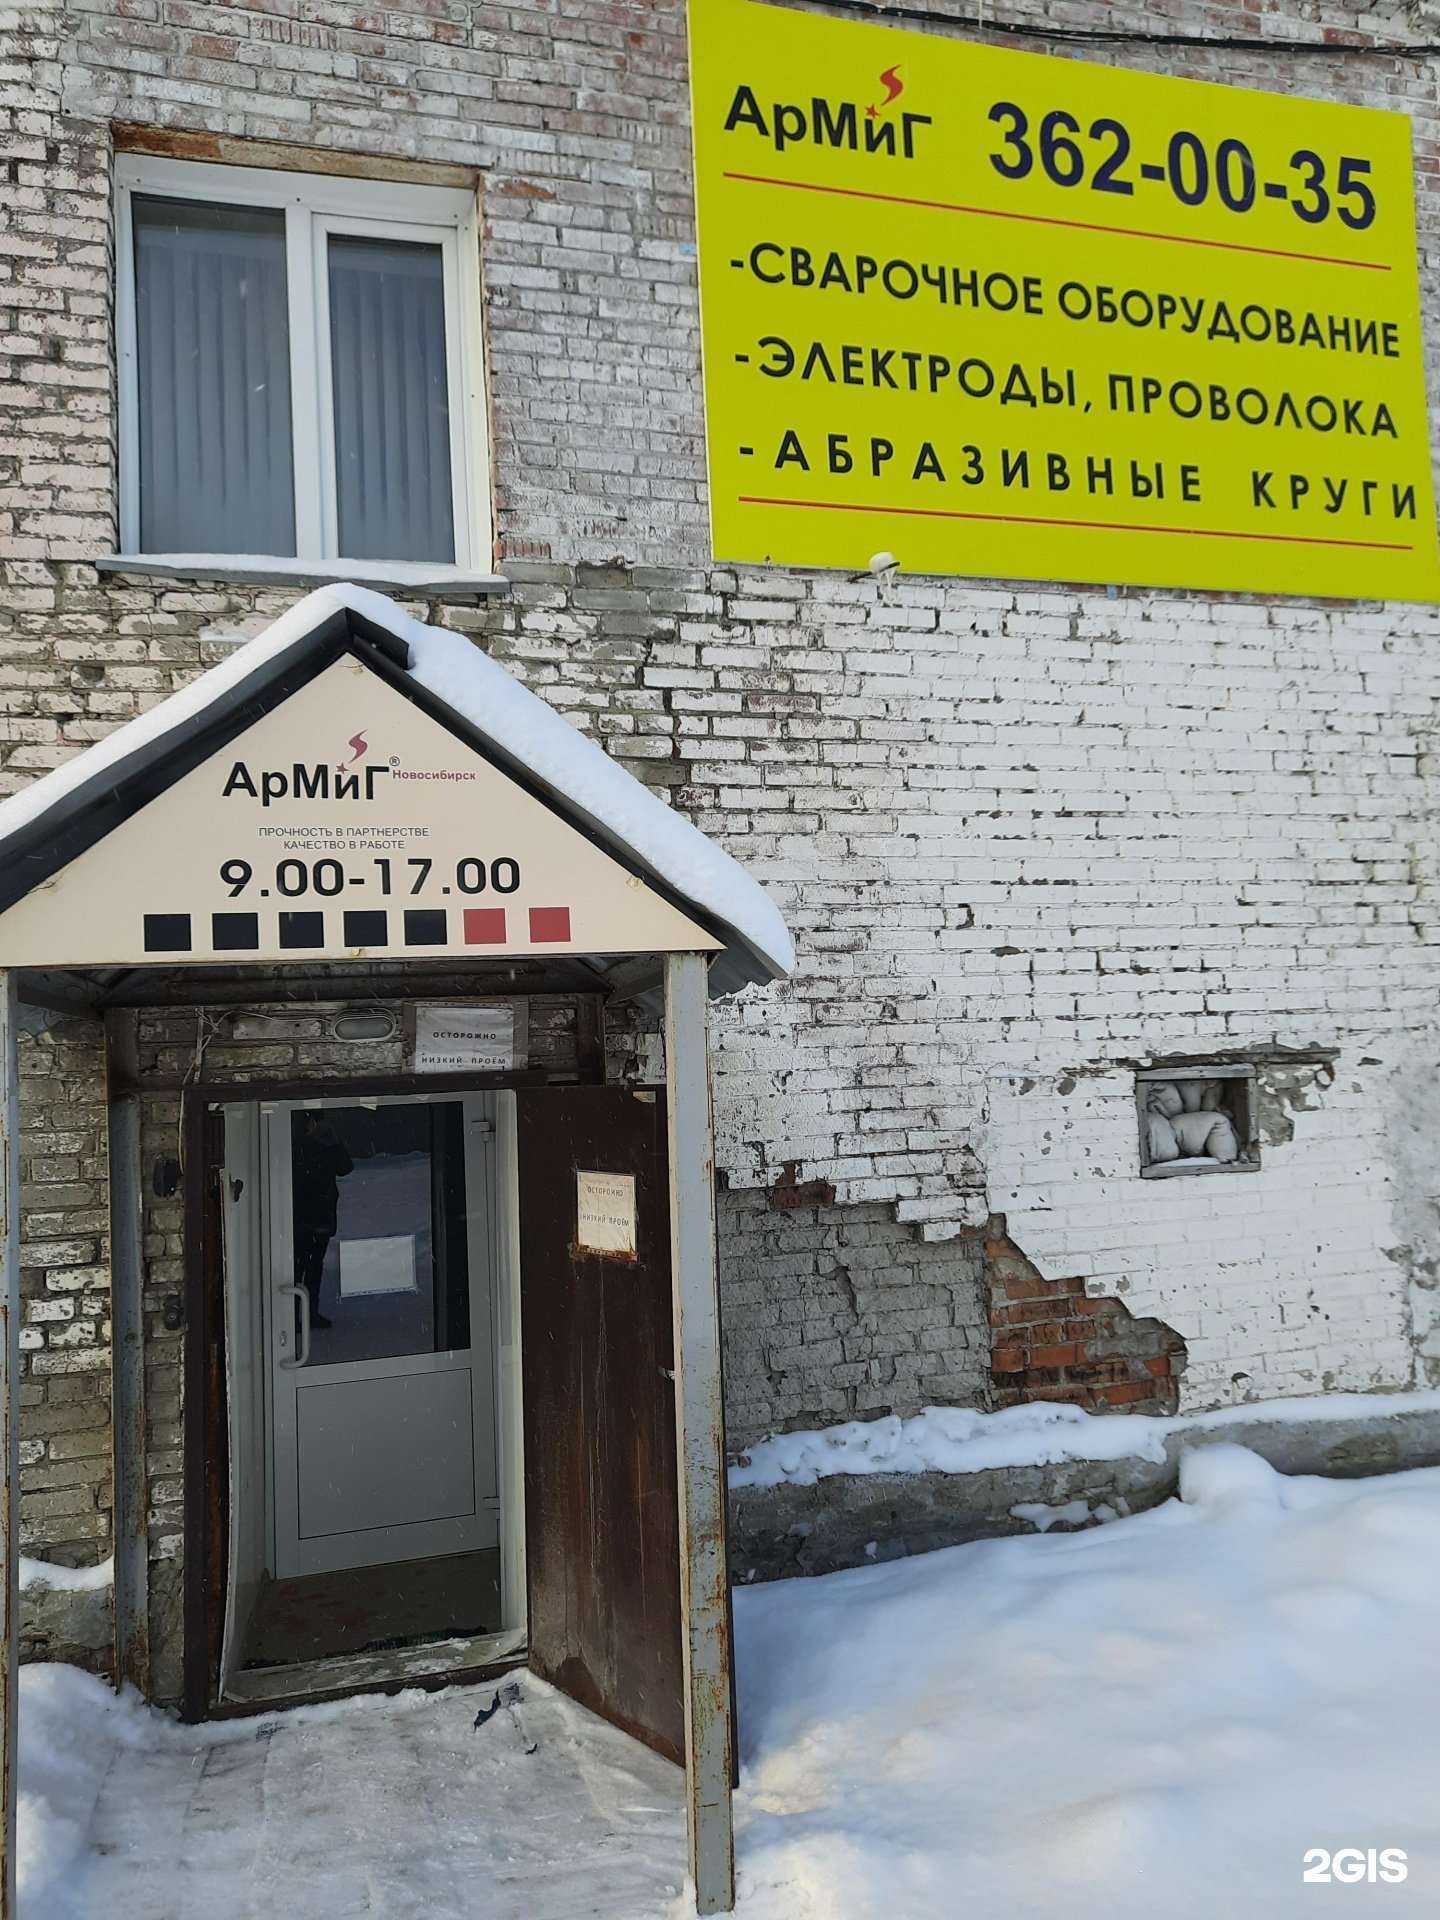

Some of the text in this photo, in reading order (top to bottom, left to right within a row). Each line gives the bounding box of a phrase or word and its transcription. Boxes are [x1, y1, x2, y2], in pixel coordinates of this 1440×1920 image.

[987, 101, 1377, 230] 362-00-35
[1059, 281, 1401, 359] ОБОРУДОВАНИЕ
[1108, 374, 1399, 439] ПРОВОЛОКА
[1252, 471, 1418, 520] КРУГИ
[392, 769, 476, 782] Новосибирск
[258, 827, 430, 837] ПРОЧНОСТЬ В ПАРТНЕРСТВЕ
[283, 840, 405, 850] КАЧЕСТВО В РАБОТЕ
[220, 857, 521, 898] 9.00-17.00
[432, 1031, 497, 1040] ОСТОРОЖНО
[421, 1056, 463, 1064] НИЗКИЙ
